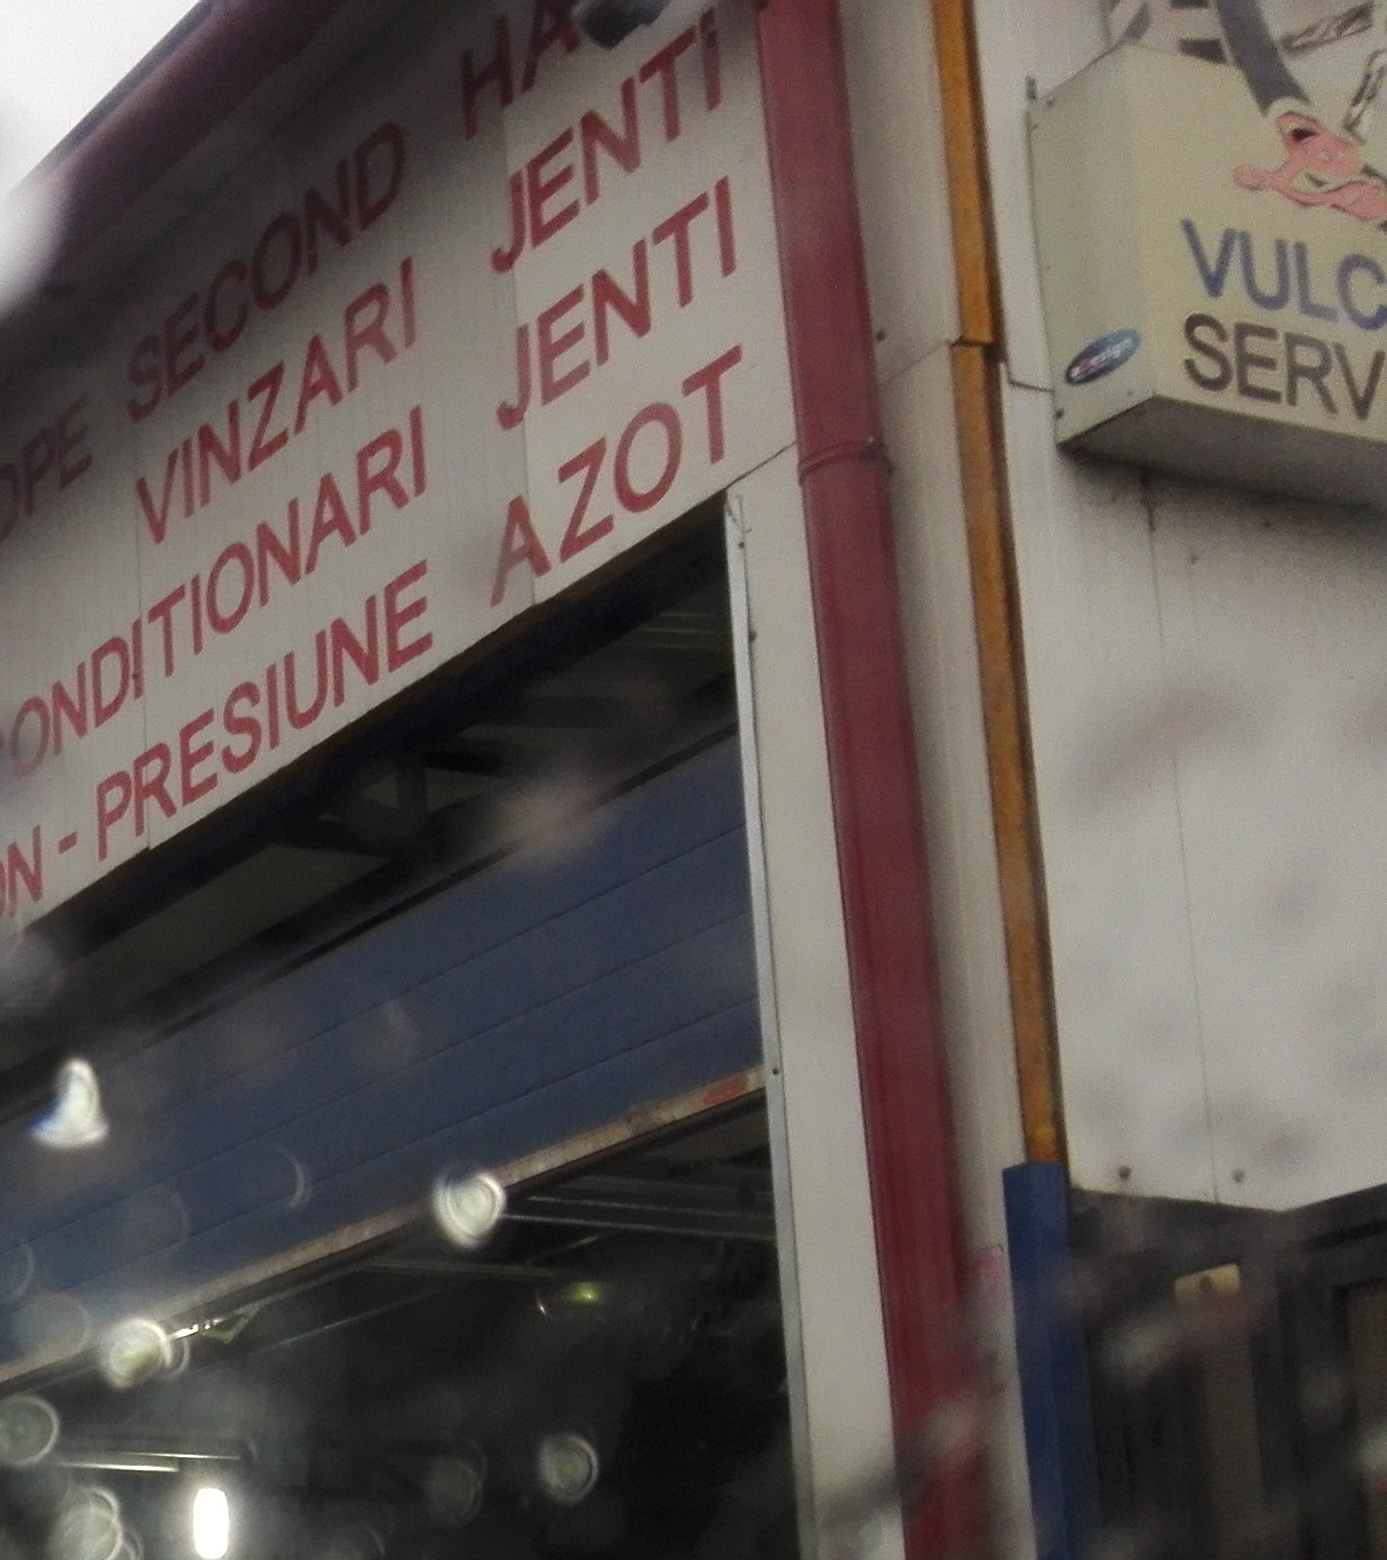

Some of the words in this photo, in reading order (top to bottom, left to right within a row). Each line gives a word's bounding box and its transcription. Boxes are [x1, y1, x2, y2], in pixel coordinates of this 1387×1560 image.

[127, 121, 407, 423] SECOND
[135, 258, 416, 545] VINZARI
[491, 11, 723, 274] JENTI
[497, 177, 739, 431] JENTI
[95, 558, 435, 863] PRESIUNE
[490, 345, 743, 607] AZOT
